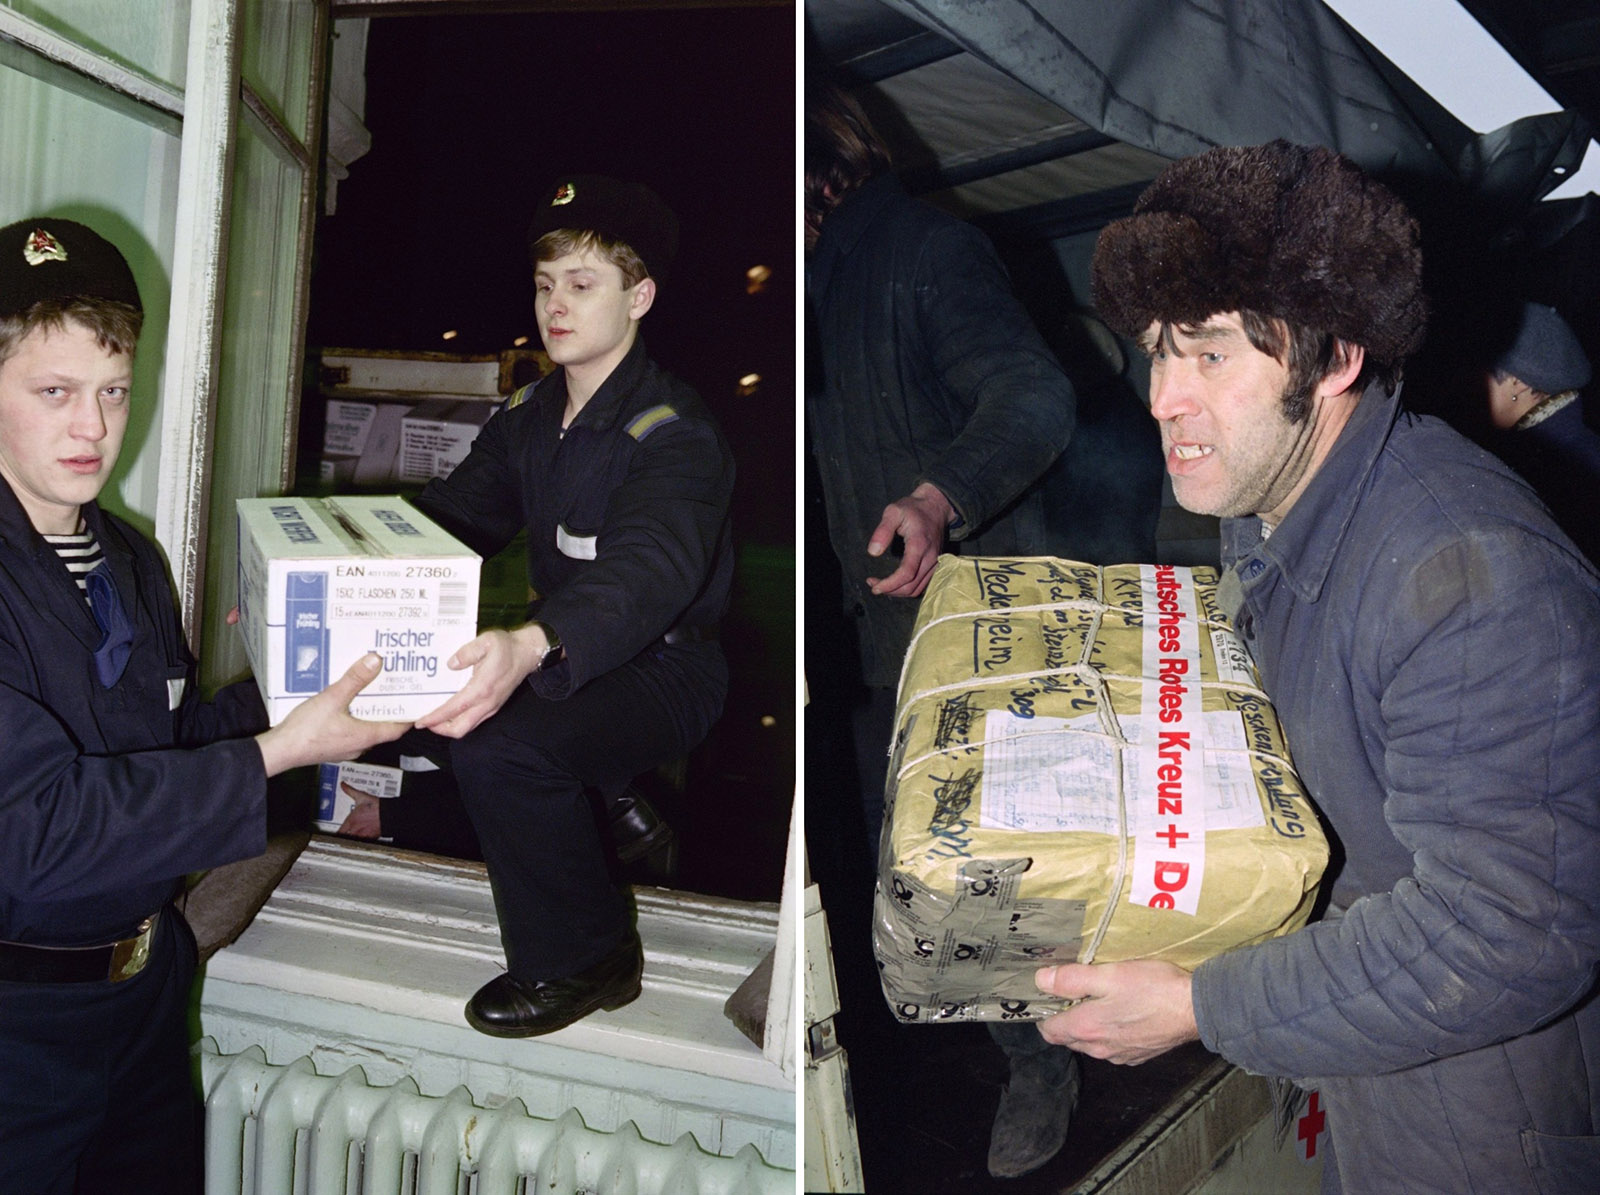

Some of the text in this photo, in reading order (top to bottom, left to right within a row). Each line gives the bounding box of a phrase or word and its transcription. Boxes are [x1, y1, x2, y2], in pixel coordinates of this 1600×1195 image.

[336, 566, 365, 577] EAN
[405, 567, 452, 578] 27360
[335, 588, 354, 598] 15X2
[358, 587, 397, 599] FLASCHEN
[400, 588, 416, 599] 250
[375, 628, 435, 648] Irischer
[1158, 659, 1189, 723] Rotes
[1157, 731, 1190, 816] Kreuz
